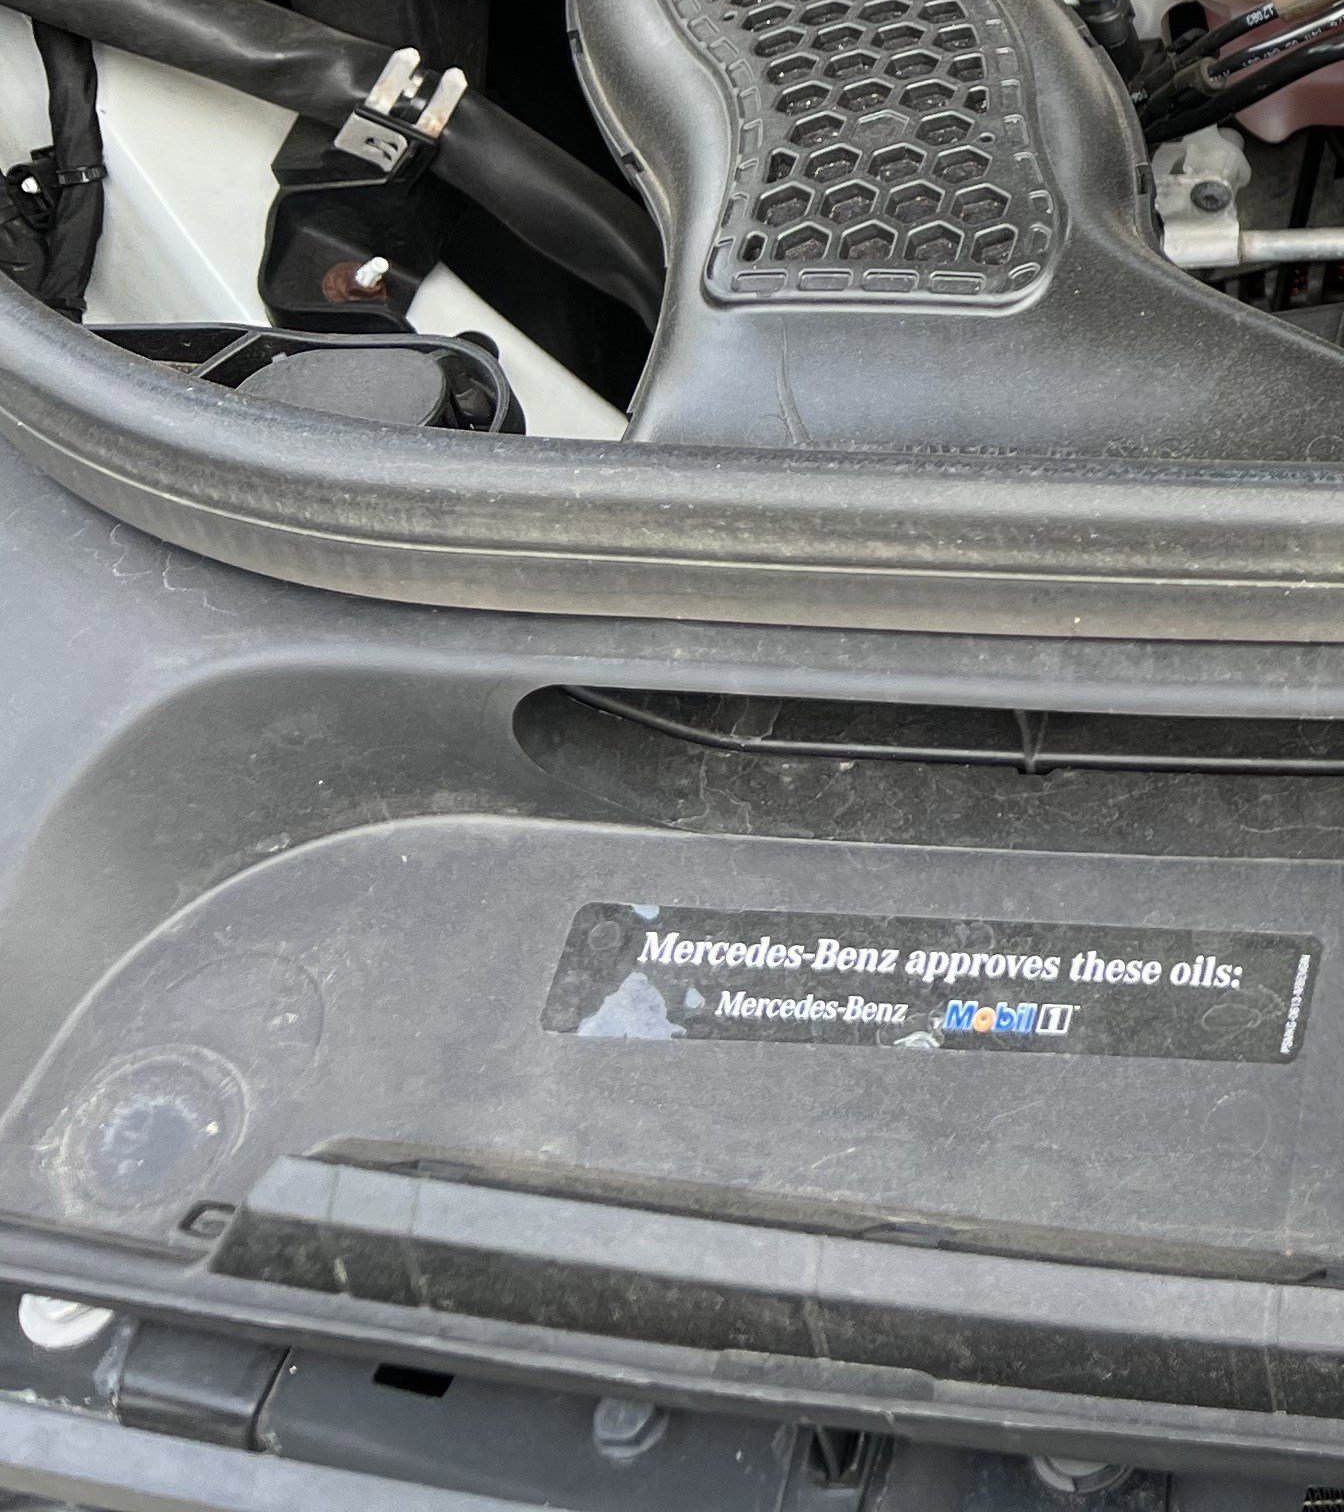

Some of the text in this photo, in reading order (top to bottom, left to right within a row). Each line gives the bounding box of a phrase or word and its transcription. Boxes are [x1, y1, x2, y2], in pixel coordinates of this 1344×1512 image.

[637, 931, 1243, 988] Mercedes-Benz approves these oils:
[714, 990, 909, 1025] Mercedes-Benz
[943, 999, 1038, 1033] Mobil
